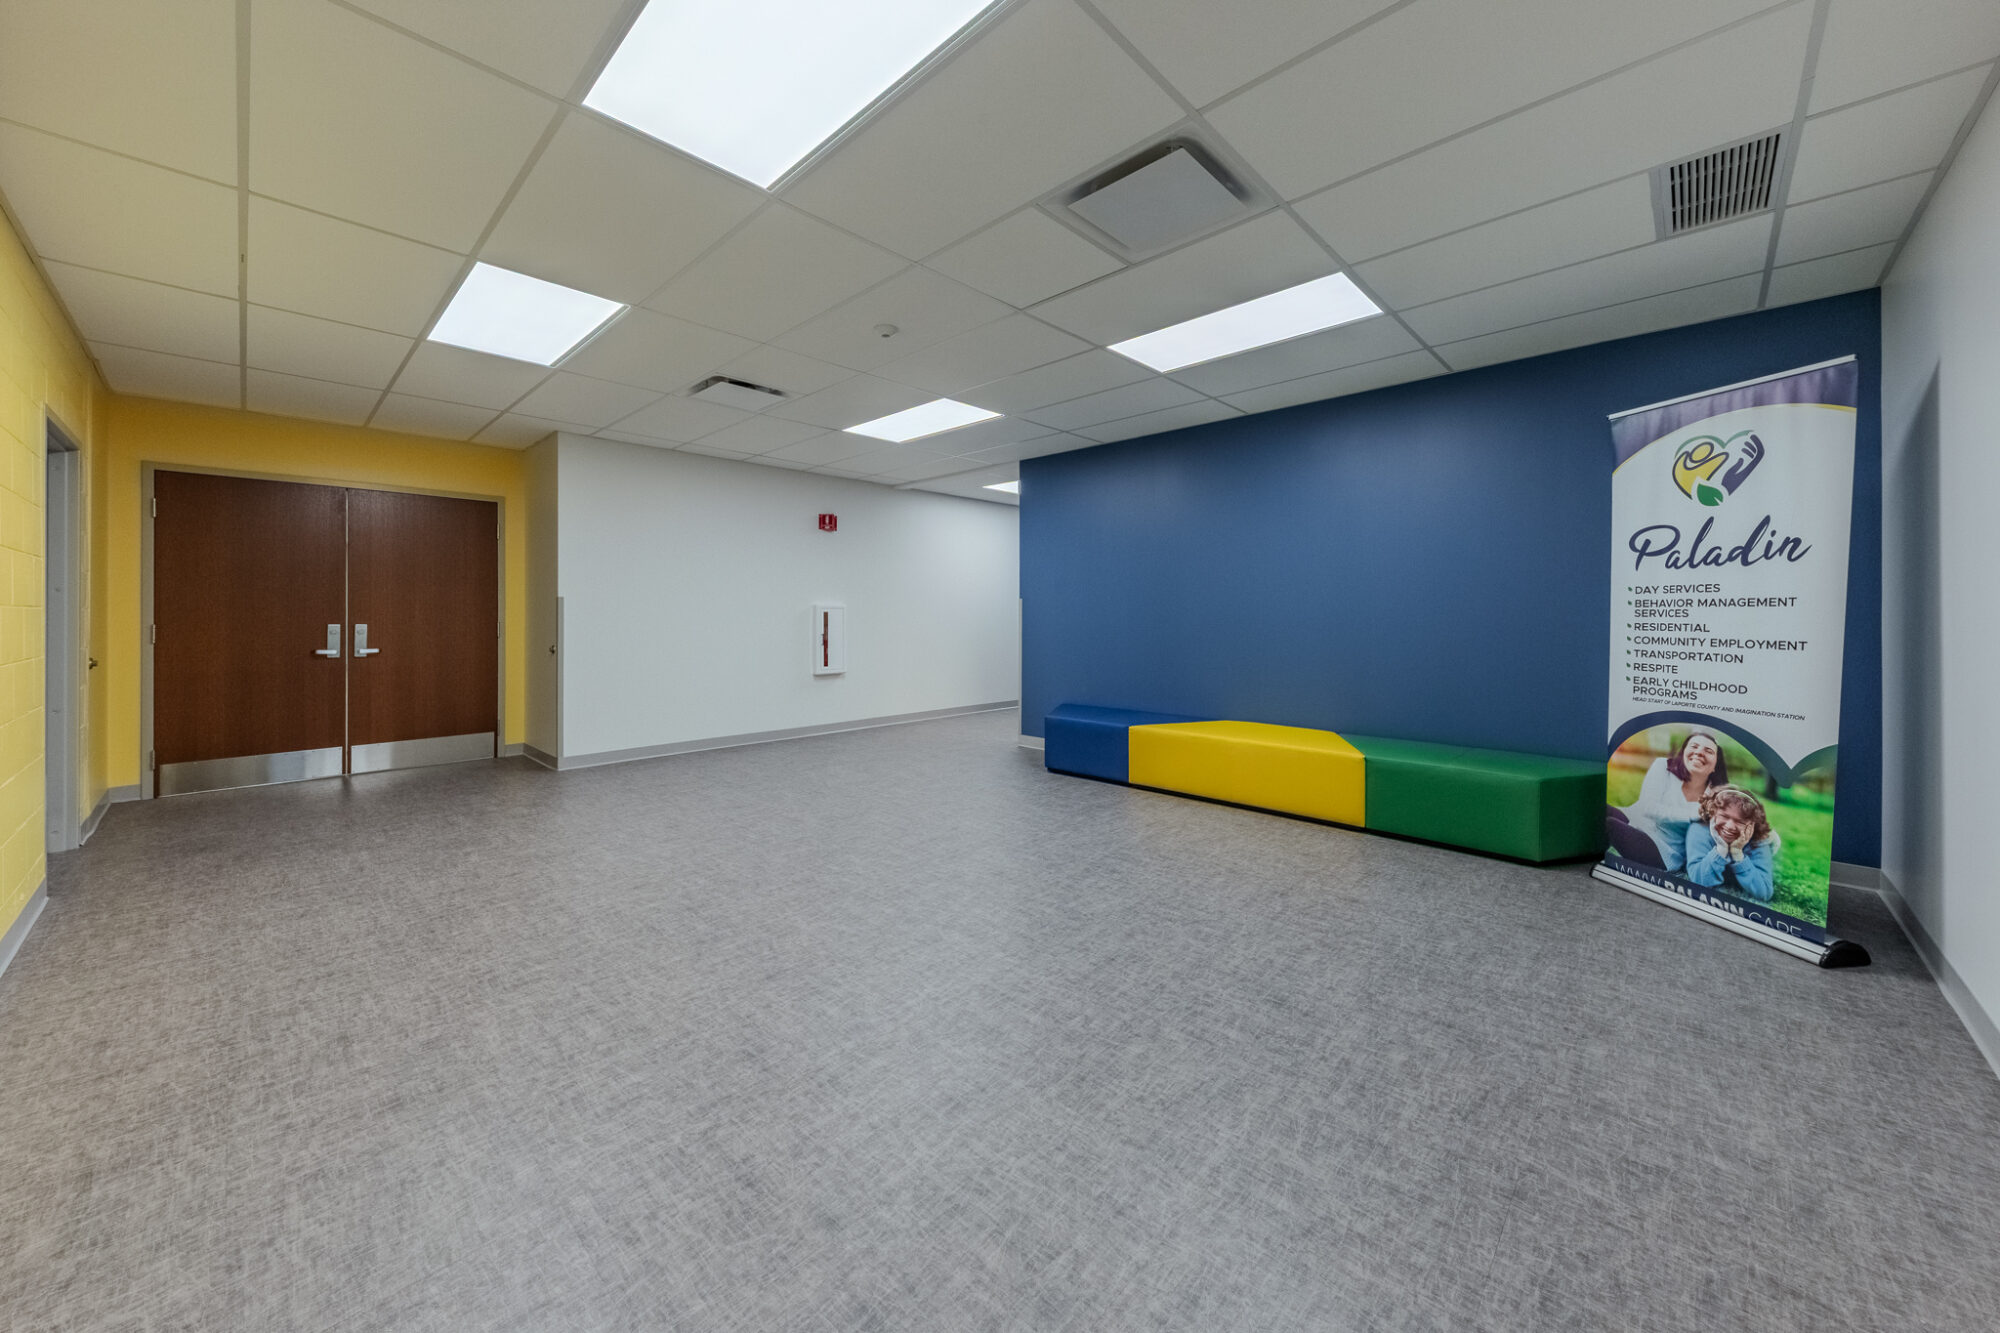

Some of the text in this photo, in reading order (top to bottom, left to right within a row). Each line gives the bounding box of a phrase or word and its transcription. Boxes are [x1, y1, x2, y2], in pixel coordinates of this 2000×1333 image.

[1628, 514, 1812, 571] Paladin
[1635, 583, 1721, 595] DAY SERVICES
[1634, 597, 1798, 608] BEHAVIOR MANAGEMENT
[1634, 609, 1689, 618] SERVICES
[1634, 623, 1711, 633] RESIDENTIAL
[1634, 636, 1808, 651] COMMUNITY EMPLOYMENT
[1634, 649, 1744, 664] TRANSPORTATION
[1633, 663, 1679, 674] RESPITE
[1633, 676, 1748, 694] EARLY CHILDHOOD
[1633, 686, 1698, 700] PROGRAMS
[1735, 708, 1776, 717] IMAGINATION
[1777, 712, 1806, 720] STATION
